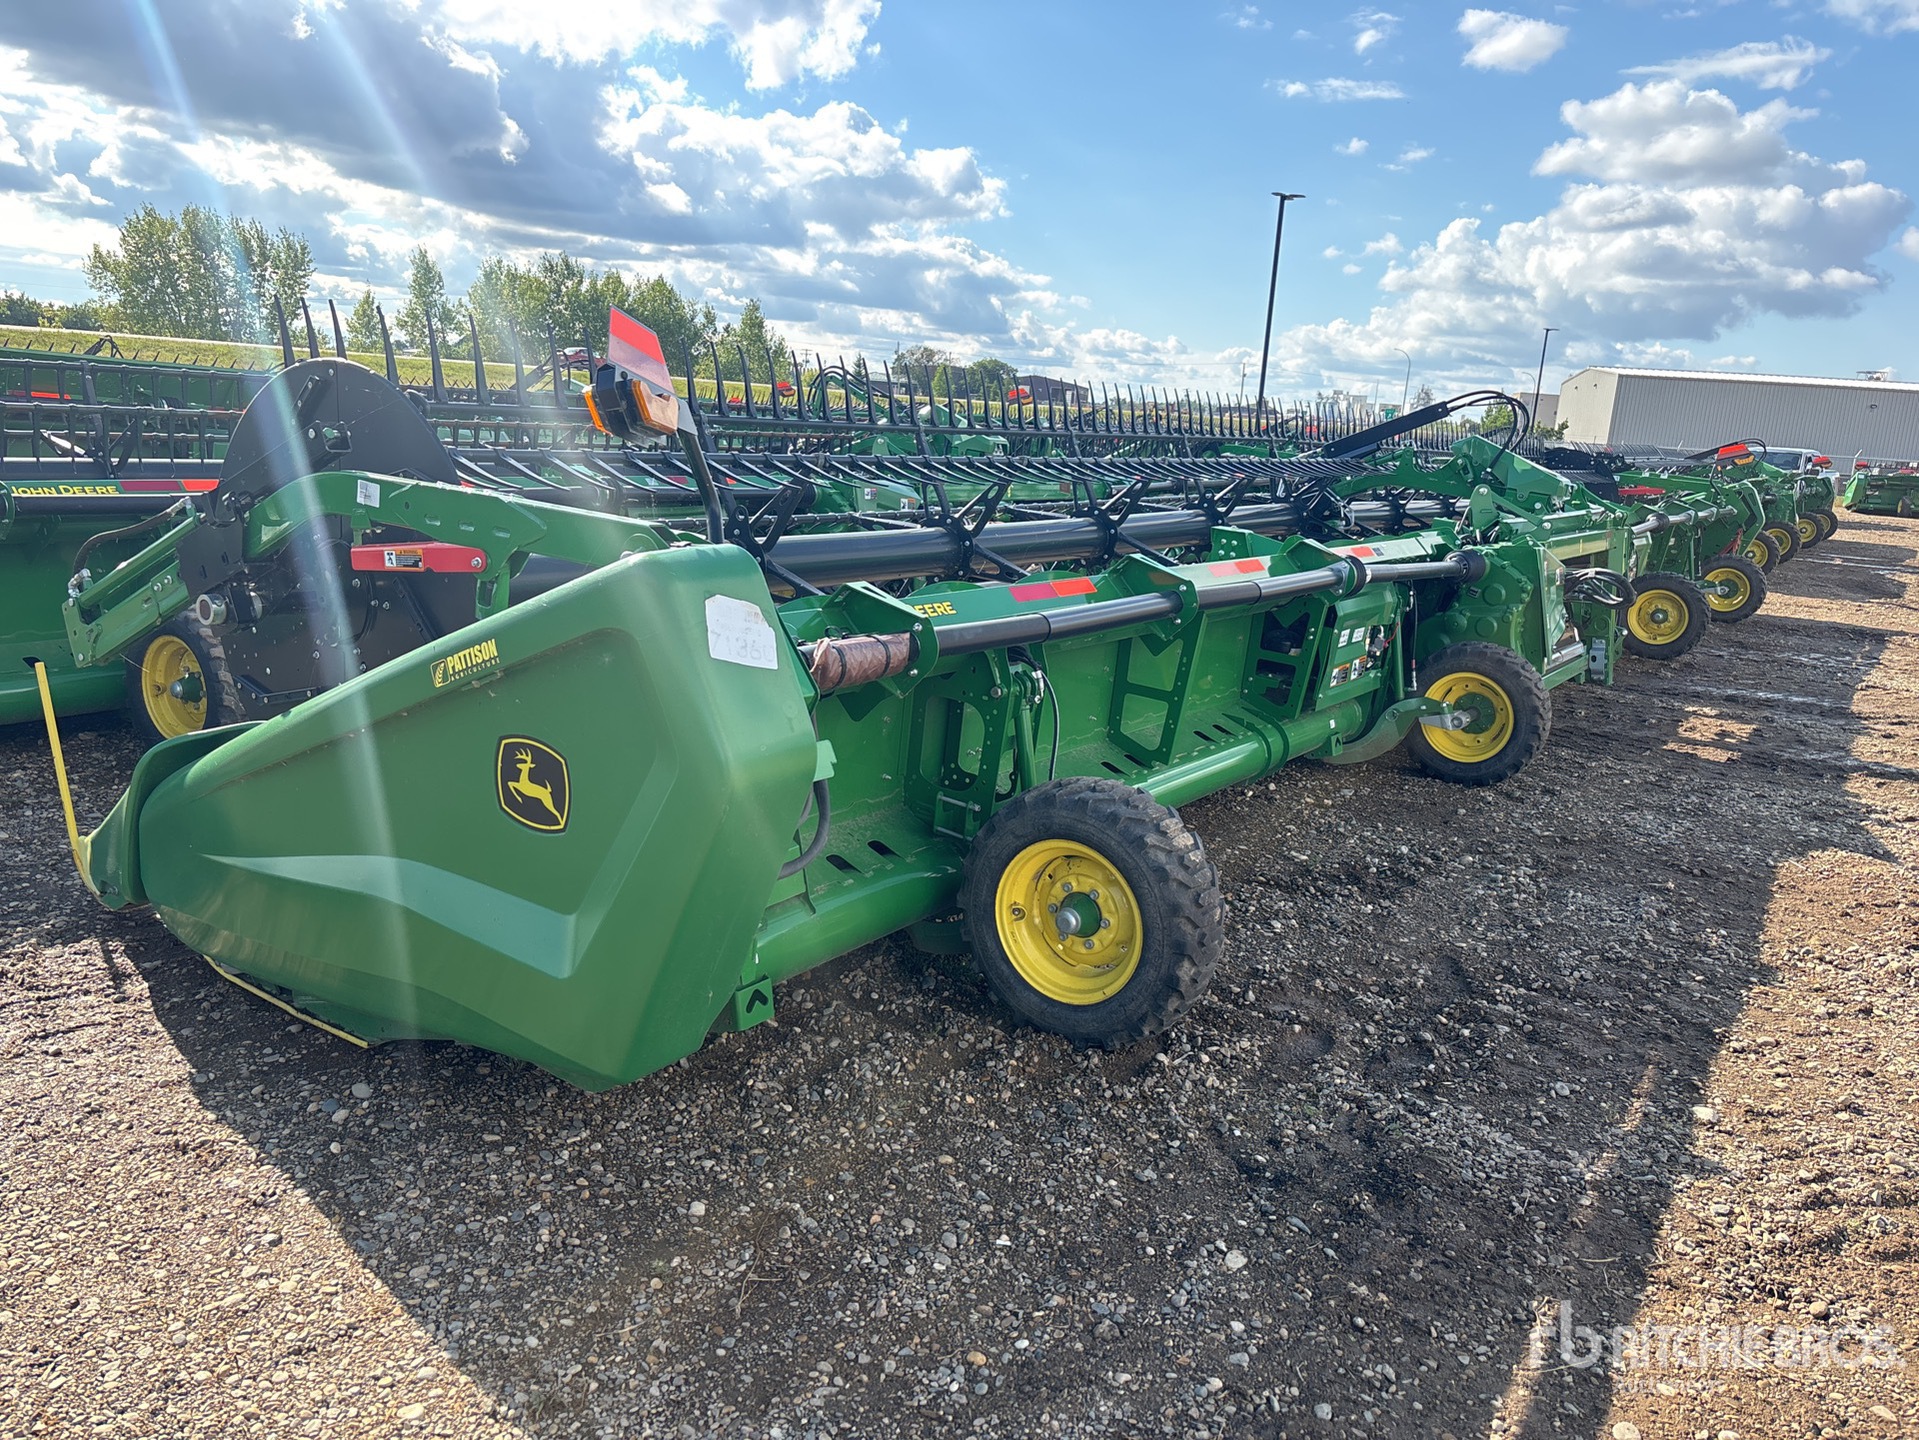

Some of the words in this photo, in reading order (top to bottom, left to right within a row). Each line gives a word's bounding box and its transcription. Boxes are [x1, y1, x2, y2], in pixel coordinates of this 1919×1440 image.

[11, 485, 57, 495] JOHN
[58, 485, 119, 495] DEERE
[914, 601, 957, 617] EERE
[446, 638, 498, 675] PATTISON
[451, 657, 500, 682] AGRICULTURE
